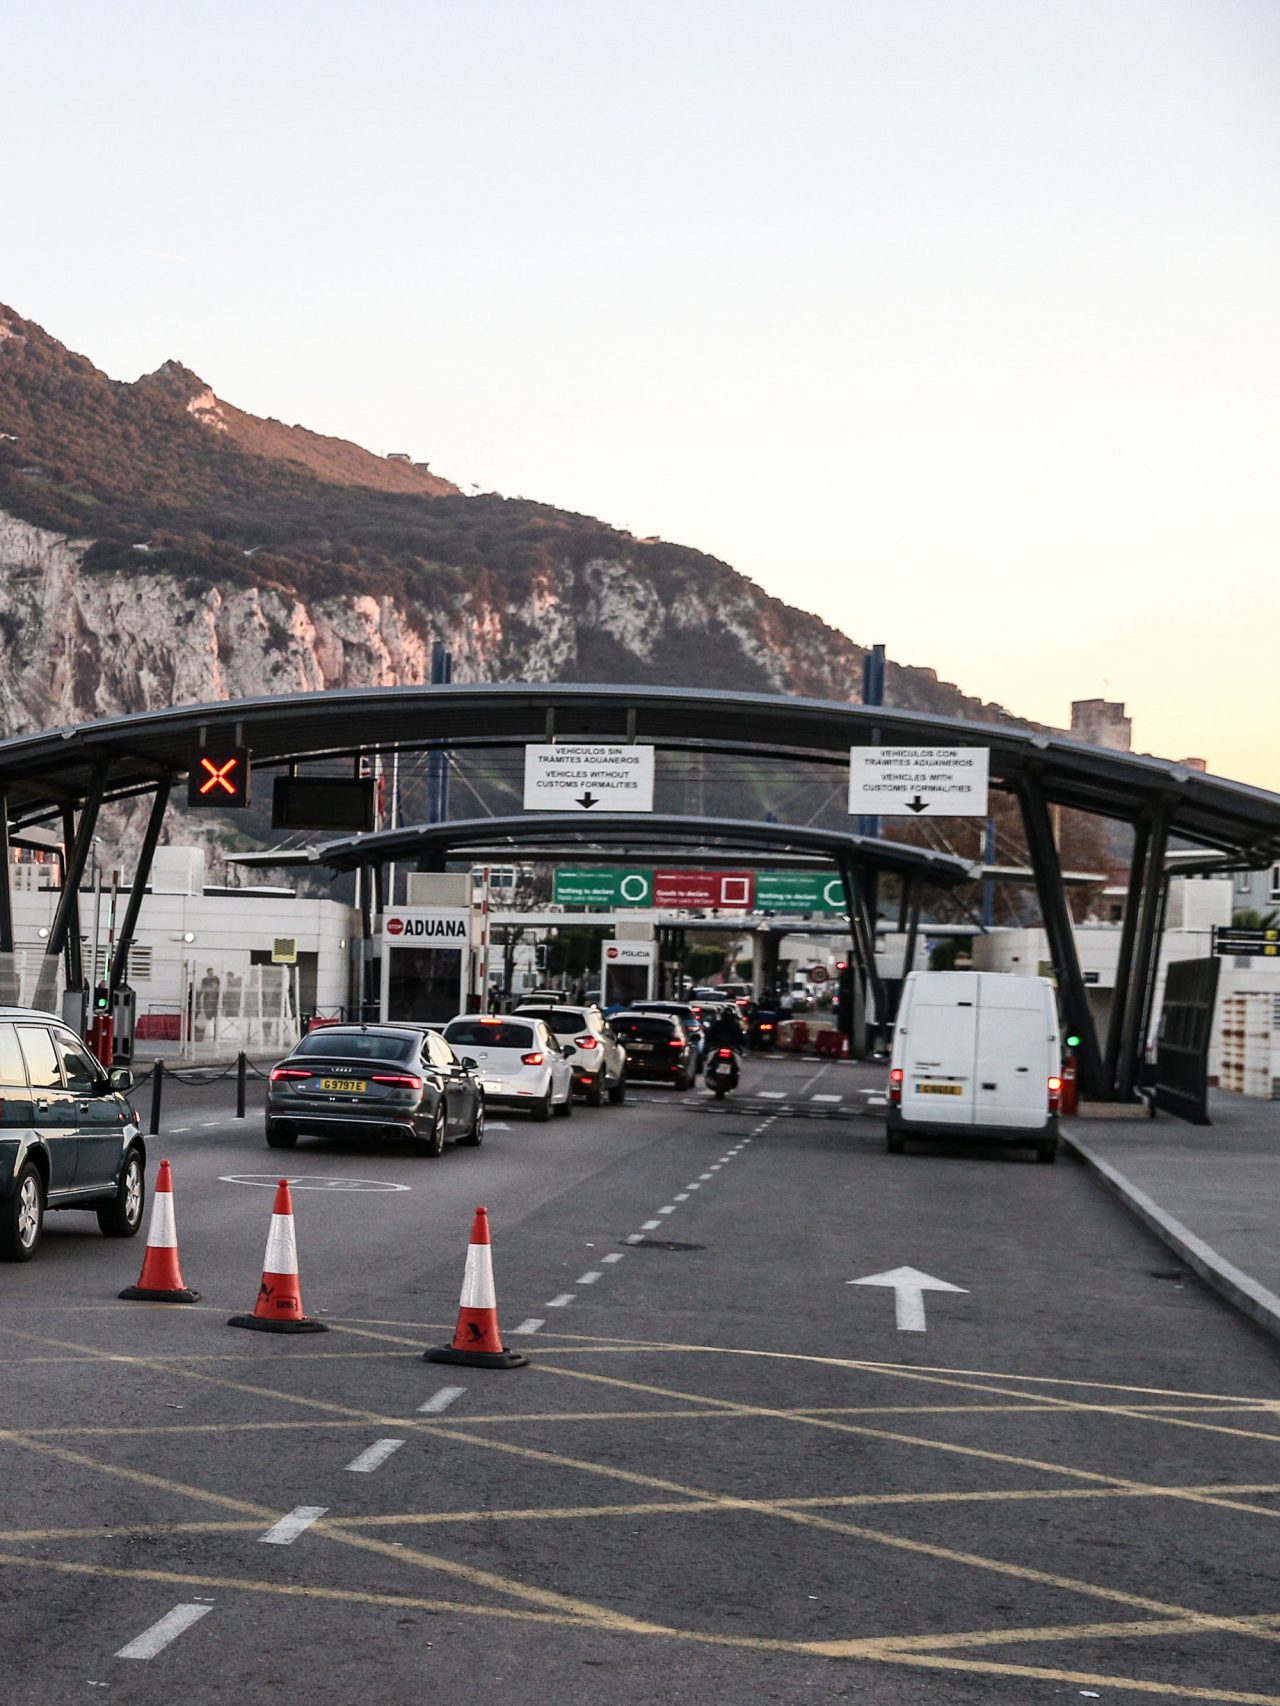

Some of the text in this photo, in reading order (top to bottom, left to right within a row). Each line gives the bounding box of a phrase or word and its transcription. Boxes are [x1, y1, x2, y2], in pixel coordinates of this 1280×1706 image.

[913, 759, 973, 767] ADUANEROS
[536, 780, 578, 788] CUSTOMS
[862, 784, 907, 792] CUSTOMS
[558, 888, 582, 896] Nothing
[404, 920, 466, 937] ADUANA
